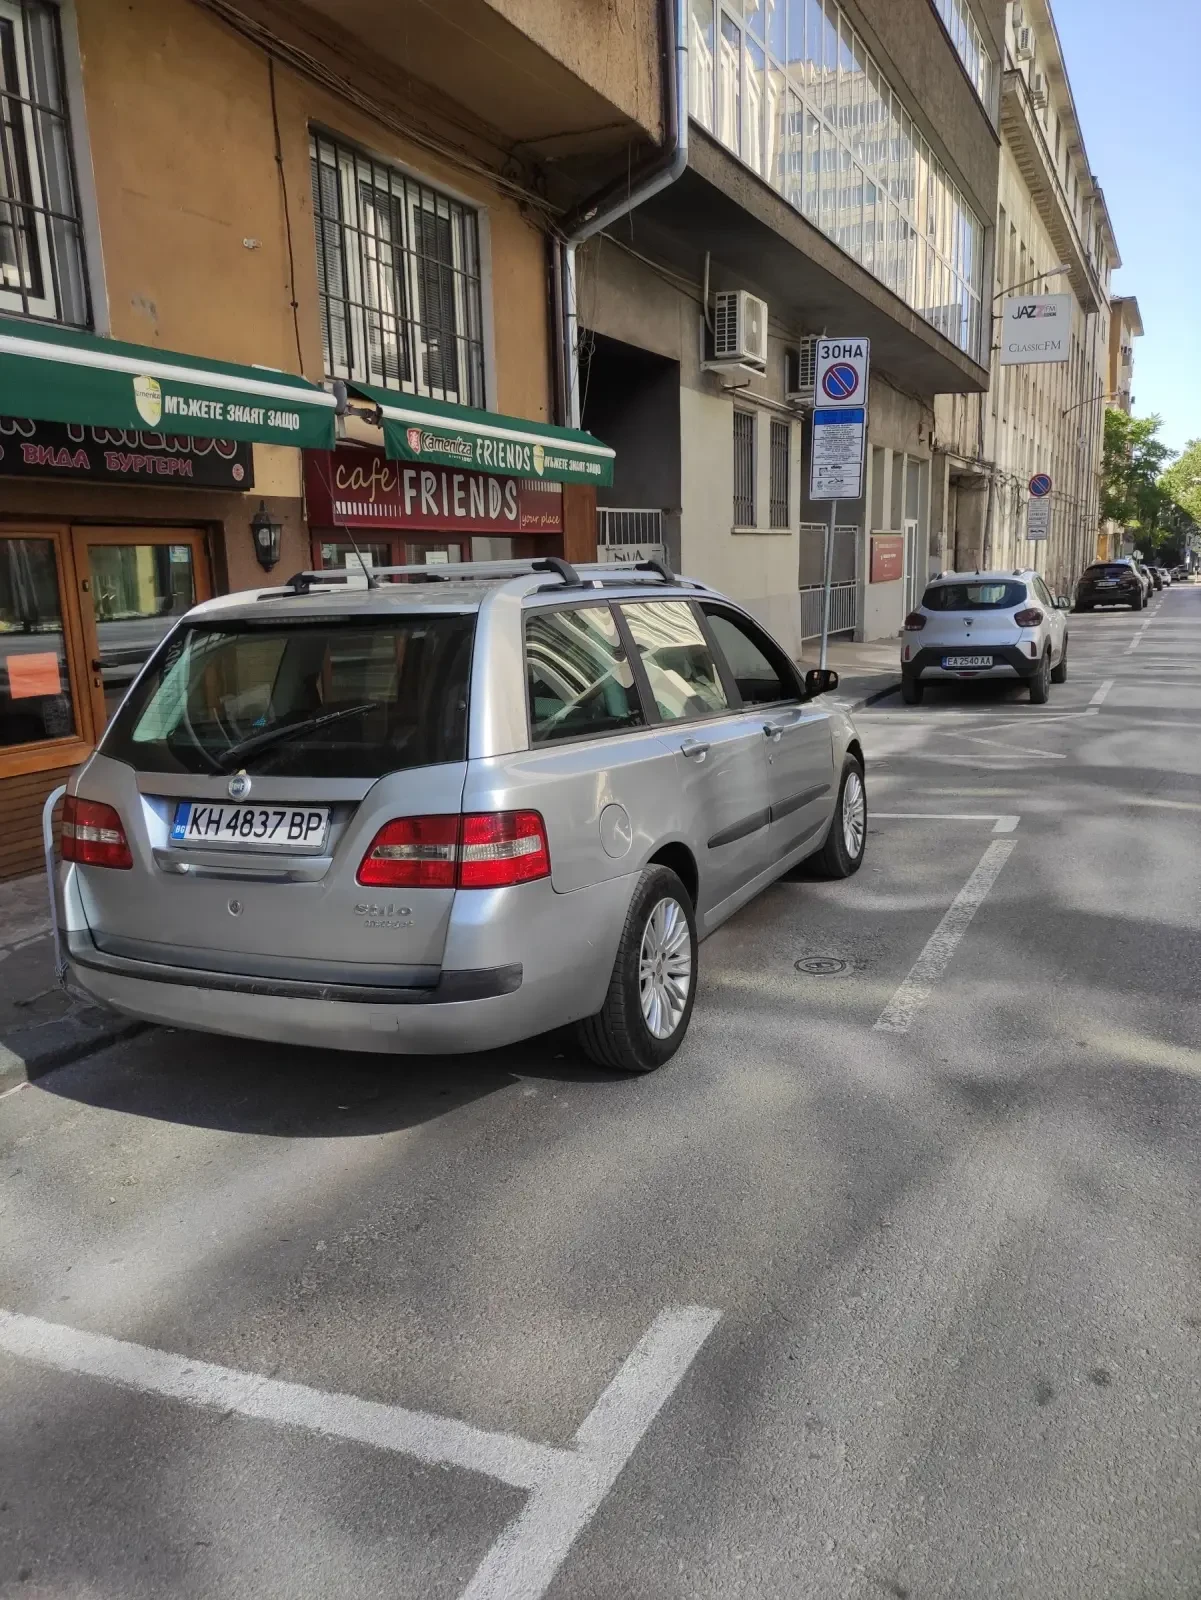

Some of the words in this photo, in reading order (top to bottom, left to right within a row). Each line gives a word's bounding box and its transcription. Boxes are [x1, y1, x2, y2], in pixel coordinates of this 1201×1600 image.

[1012, 305, 1044, 319] JAZZ
[821, 344, 864, 360] ЗОНА
[164, 395, 224, 420] МЪЖЕТЕ
[226, 404, 265, 425] ЗНАЯТ
[267, 410, 300, 431] ЗАЩО
[20, 442, 91, 470] ВИДА
[104, 450, 194, 477] БУРГЕРИ
[420, 432, 473, 456] Kamenitza
[476, 438, 531, 471] FRIENDS
[544, 455, 569, 471] МЪЖЕТЕ
[336, 457, 397, 502] cafe
[403, 469, 518, 521] FRIENDS
[521, 514, 539, 527] your
[540, 511, 561, 527] place
[947, 657, 958, 666] EA
[960, 657, 979, 665] 2540
[980, 656, 991, 665] AA
[175, 824, 186, 834] BG
[189, 807, 224, 836] KH
[225, 809, 287, 839] 4837
[287, 811, 323, 841] BP
